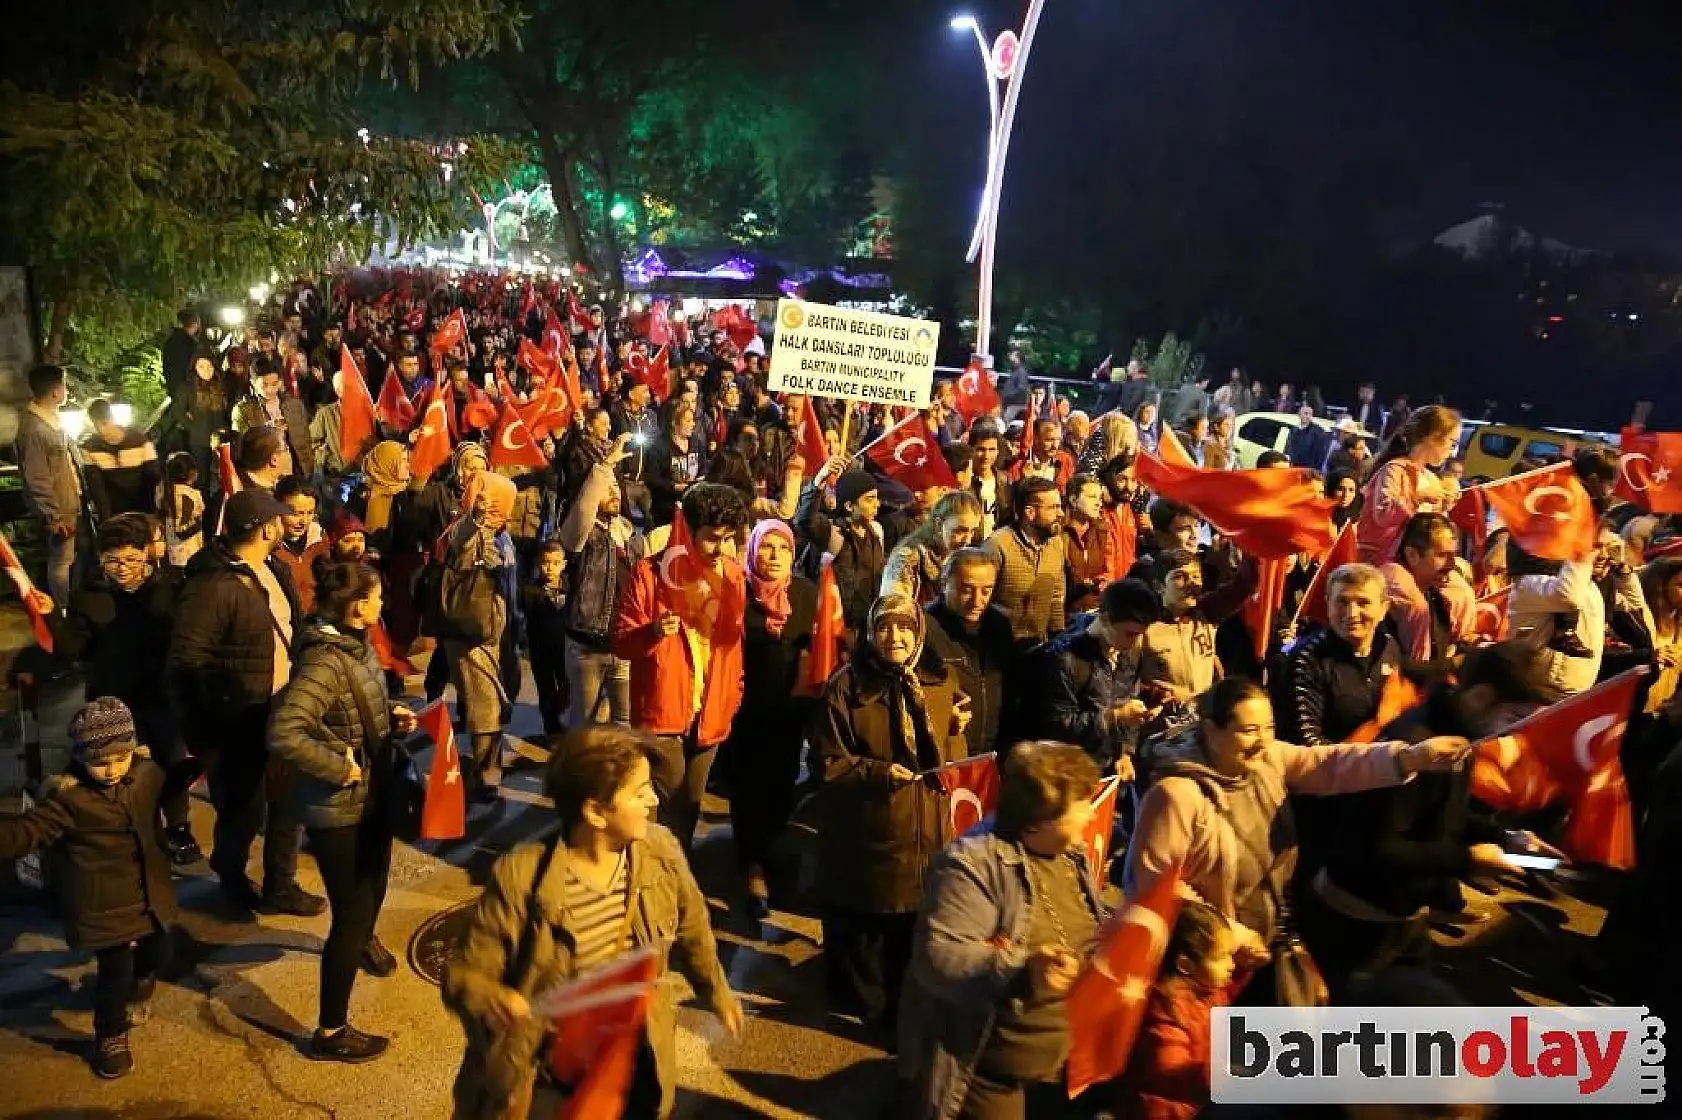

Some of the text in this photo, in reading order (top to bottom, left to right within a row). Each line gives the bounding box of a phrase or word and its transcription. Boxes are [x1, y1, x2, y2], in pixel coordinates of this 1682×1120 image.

[807, 314, 847, 331] BARTIN
[780, 334, 809, 351] HALK
[812, 338, 865, 358] DANSLARI
[801, 359, 906, 384] BARTIN MUNICIPALITY
[782, 375, 916, 403] FOLK DANCE ENSEMLE
